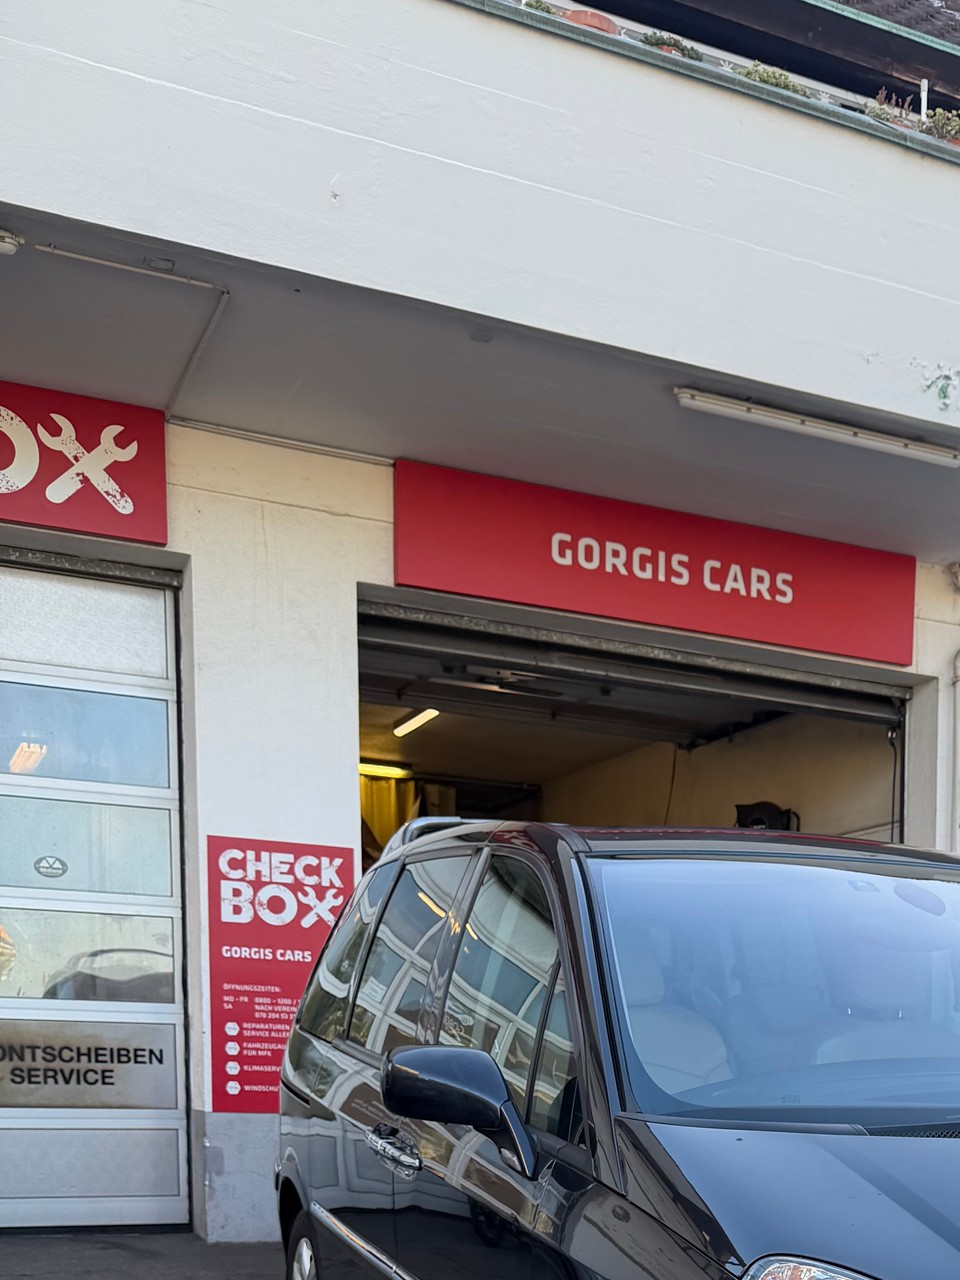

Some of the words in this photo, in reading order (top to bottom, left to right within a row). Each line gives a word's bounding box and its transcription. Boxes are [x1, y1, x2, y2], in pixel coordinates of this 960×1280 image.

[551, 532, 690, 586] GORGIS
[703, 559, 794, 604] CARS
[218, 848, 344, 889] CHECK
[222, 945, 273, 961] GORGIS
[276, 948, 312, 963] CARS
[10, 1067, 116, 1086] SERVICE
